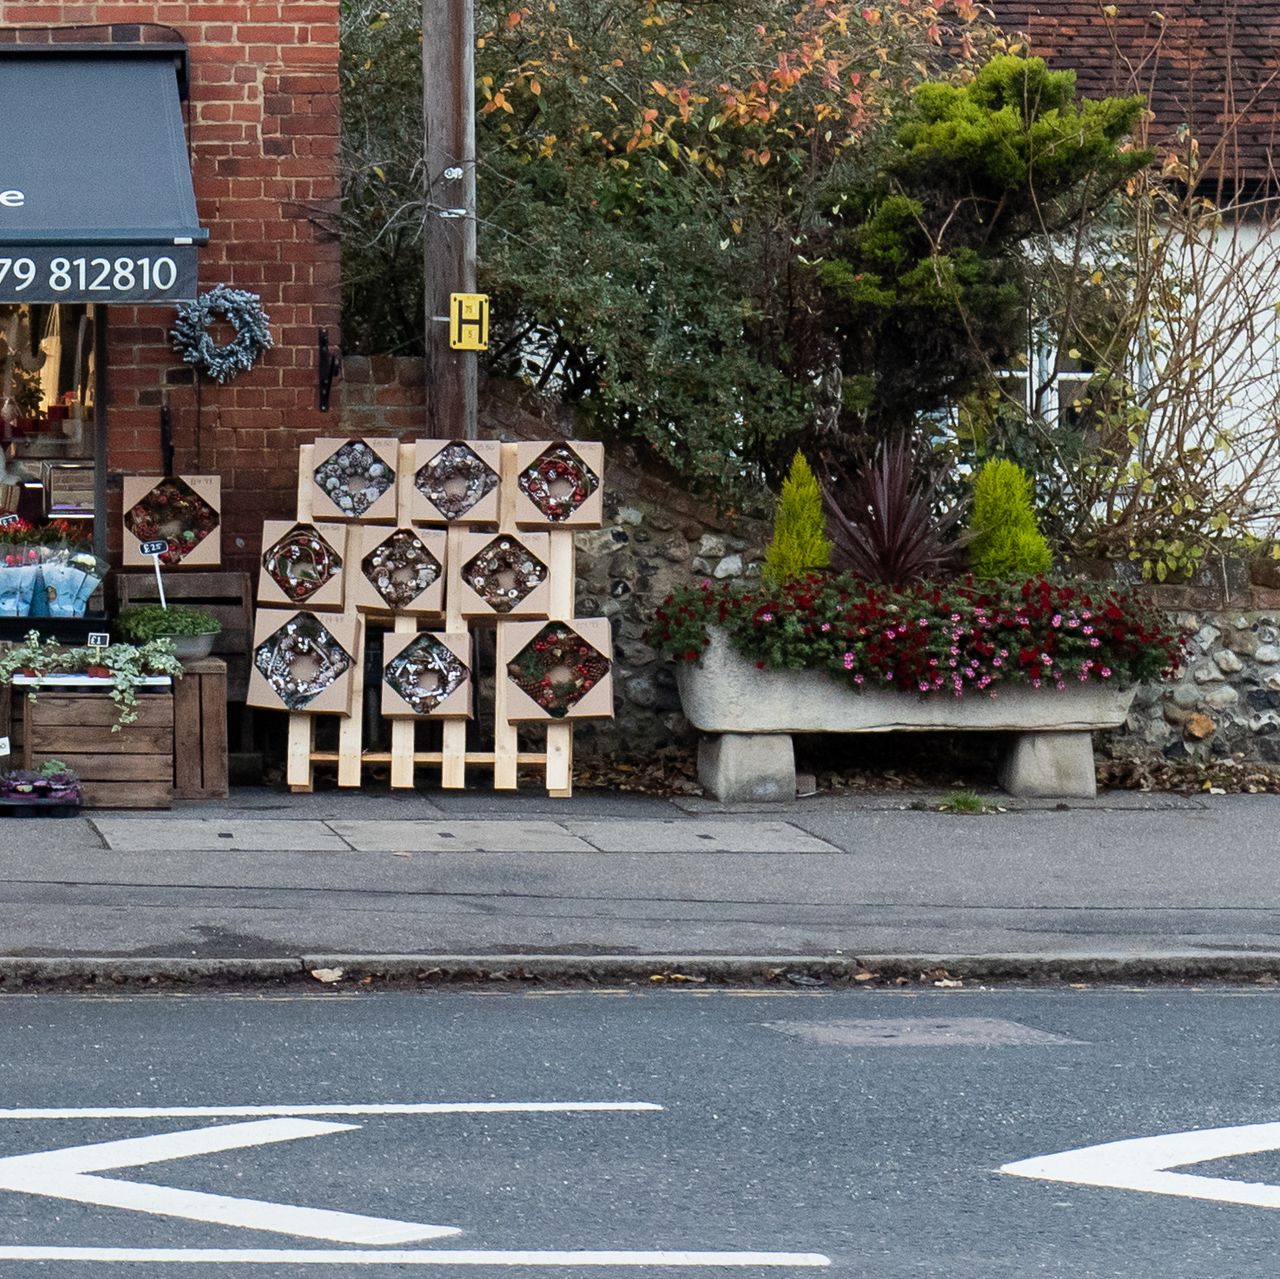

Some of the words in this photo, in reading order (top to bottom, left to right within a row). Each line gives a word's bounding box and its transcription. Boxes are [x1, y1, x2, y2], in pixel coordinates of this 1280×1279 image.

[48, 257, 178, 291] 812810
[458, 300, 483, 344] H
[143, 542, 162, 551] £25
